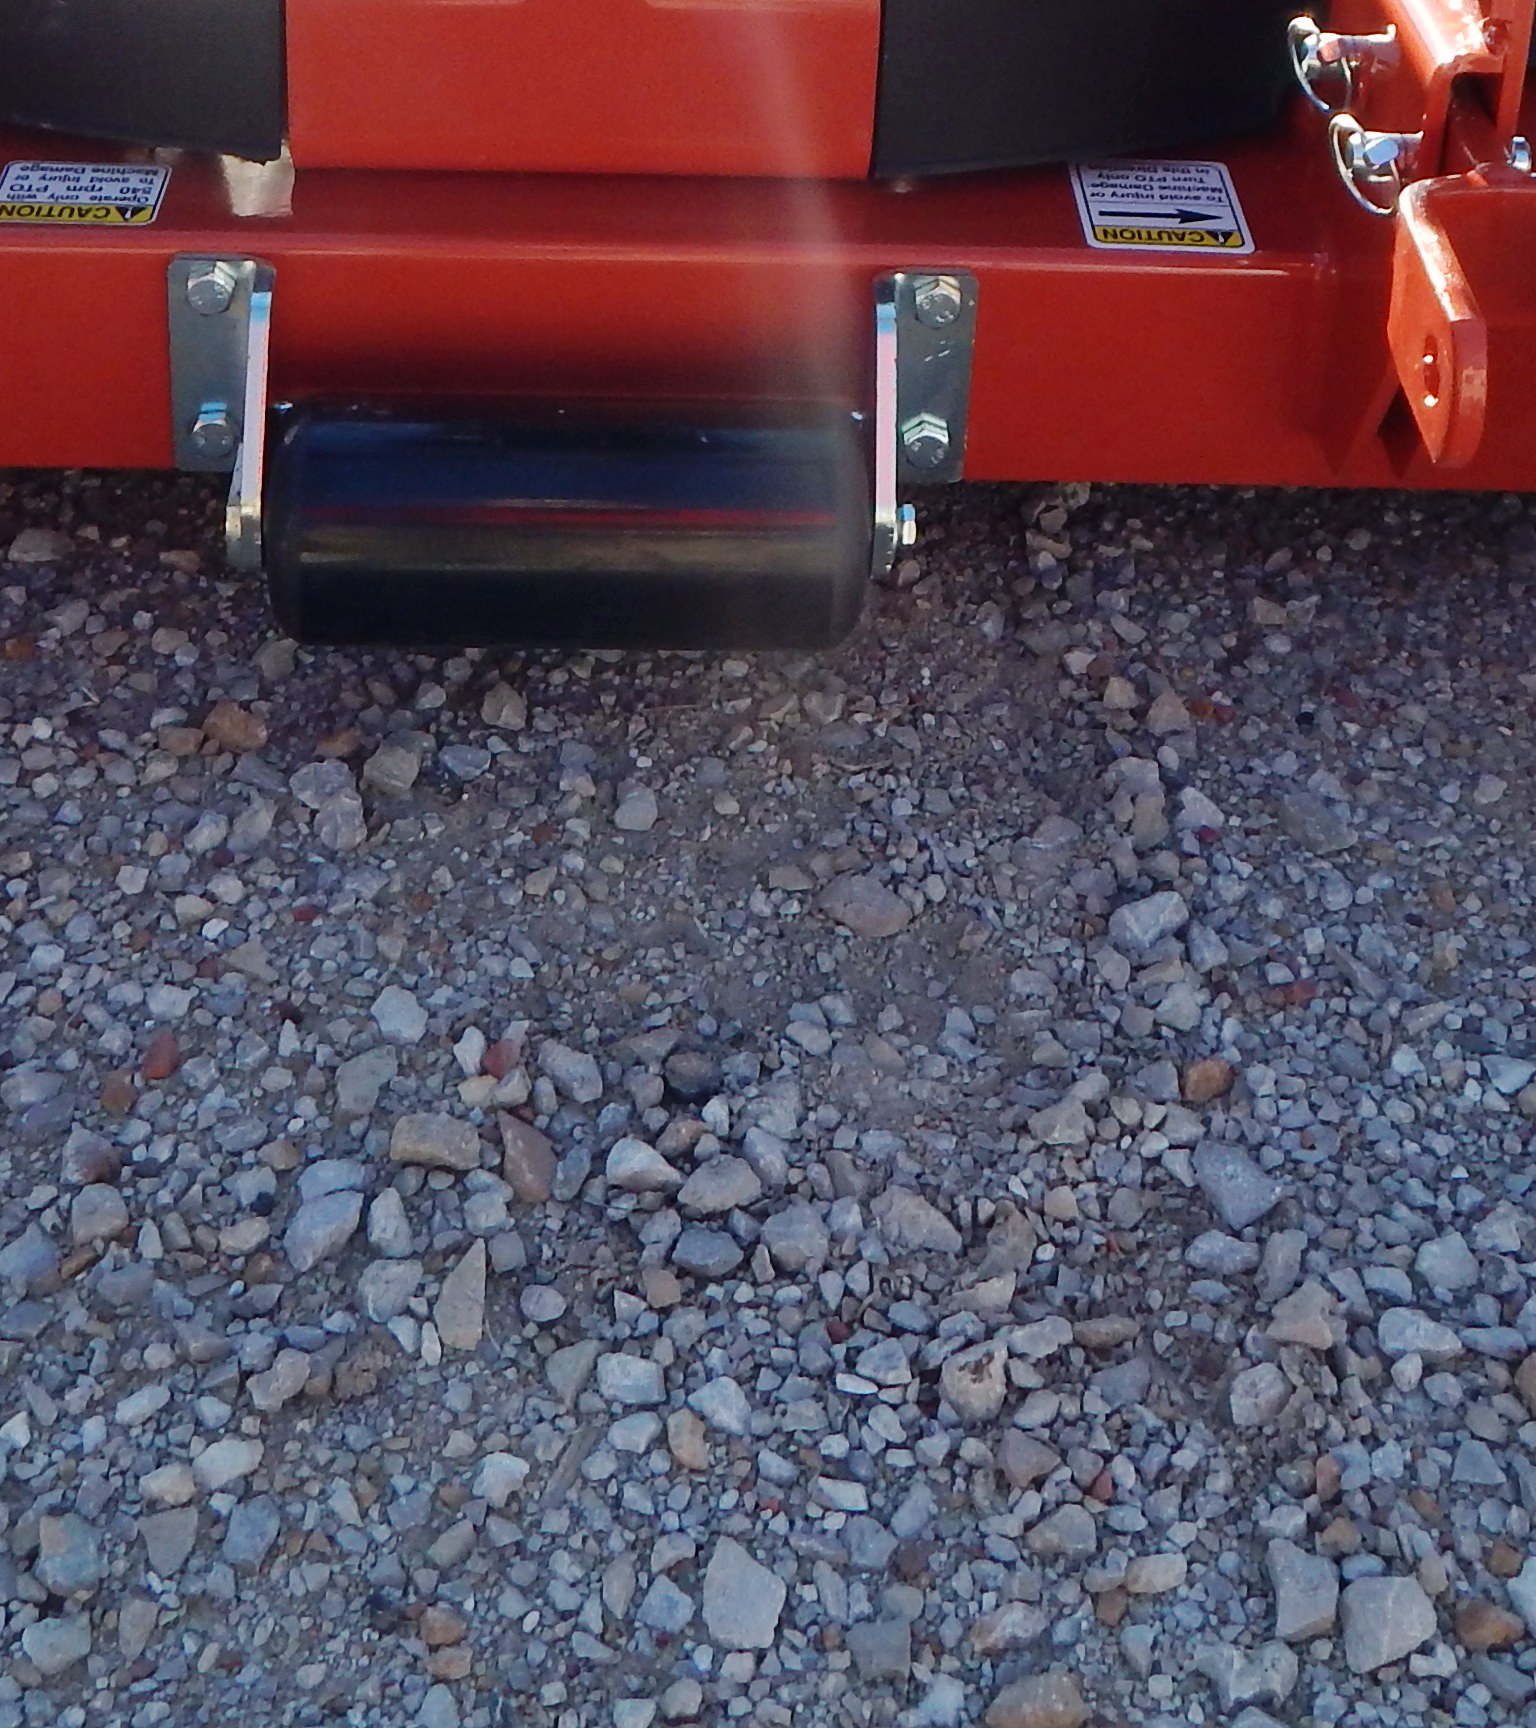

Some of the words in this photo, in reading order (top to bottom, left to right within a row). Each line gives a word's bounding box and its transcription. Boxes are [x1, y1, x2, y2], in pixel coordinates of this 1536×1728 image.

[9, 184, 50, 193] PTO
[66, 184, 104, 192] rpm
[46, 192, 80, 200] only
[89, 195, 150, 204] Operate
[1102, 228, 1206, 243] CAUTION
